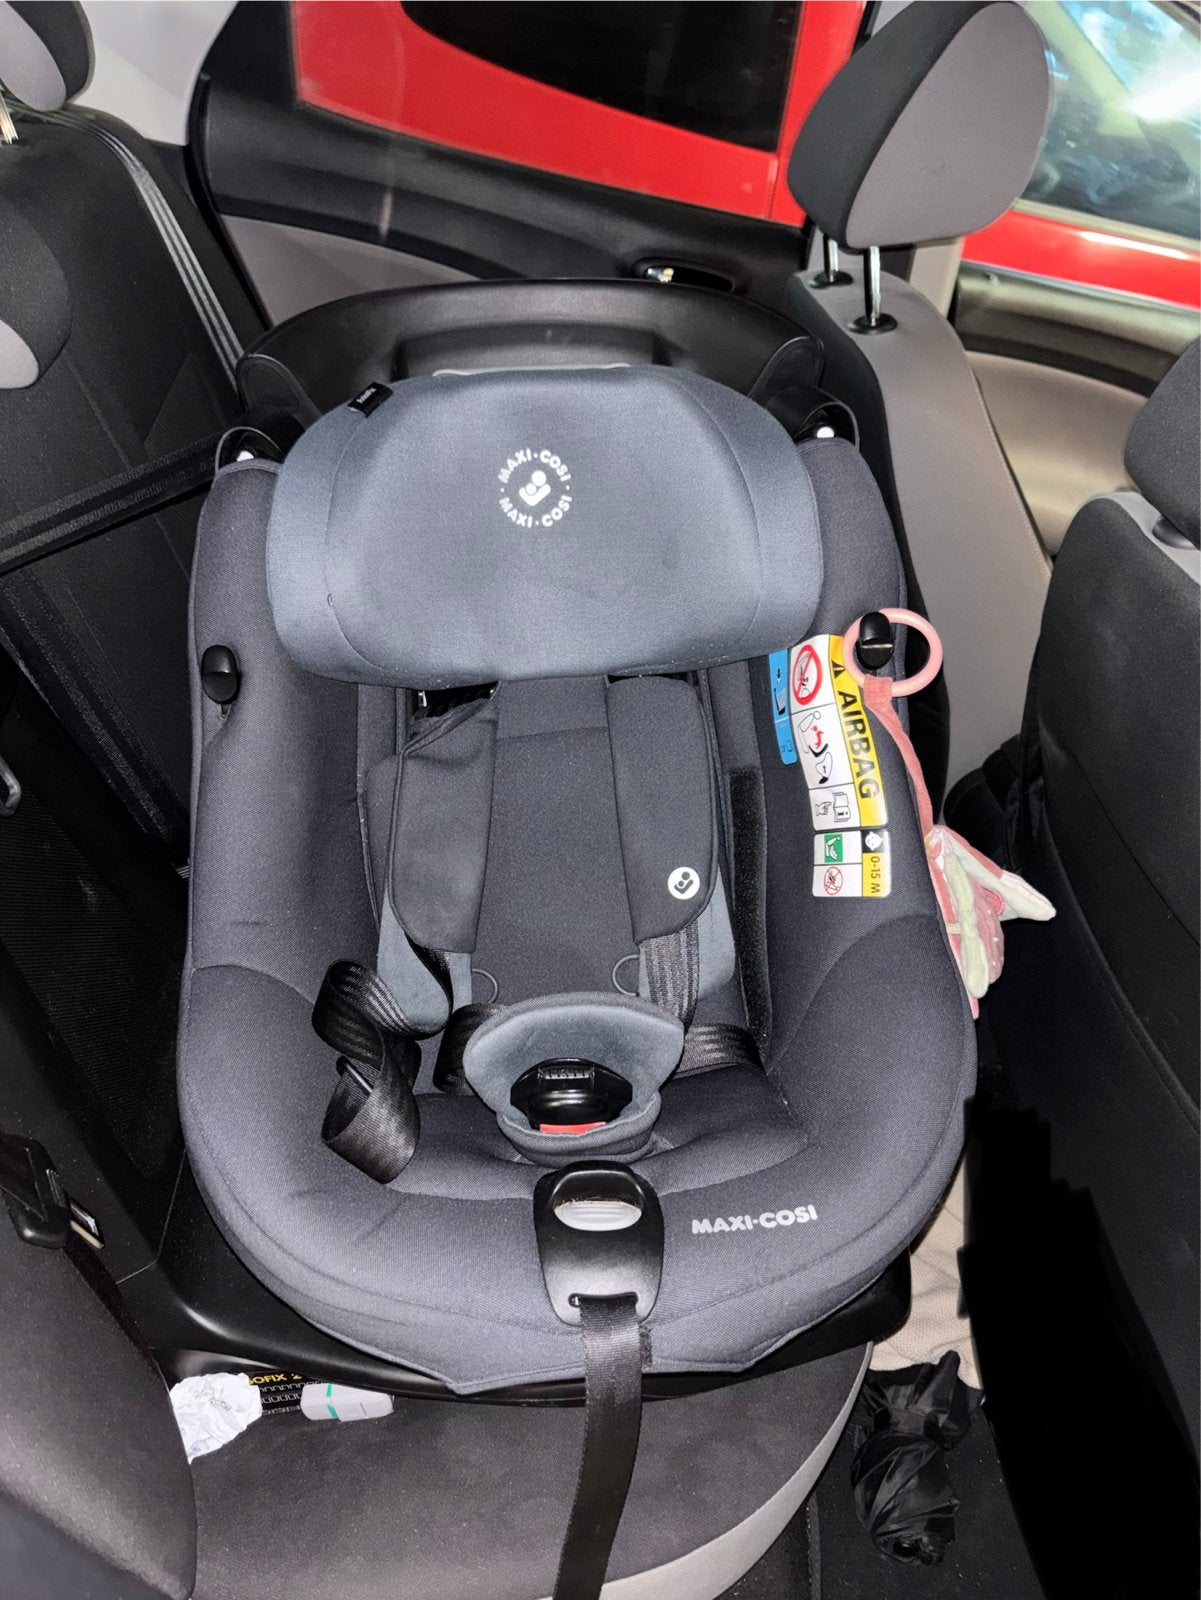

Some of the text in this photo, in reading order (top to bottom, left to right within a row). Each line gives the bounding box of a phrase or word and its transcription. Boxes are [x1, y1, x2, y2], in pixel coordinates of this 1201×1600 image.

[838, 690, 880, 799] AIRBAG
[870, 855, 881, 894] 0-15 M
